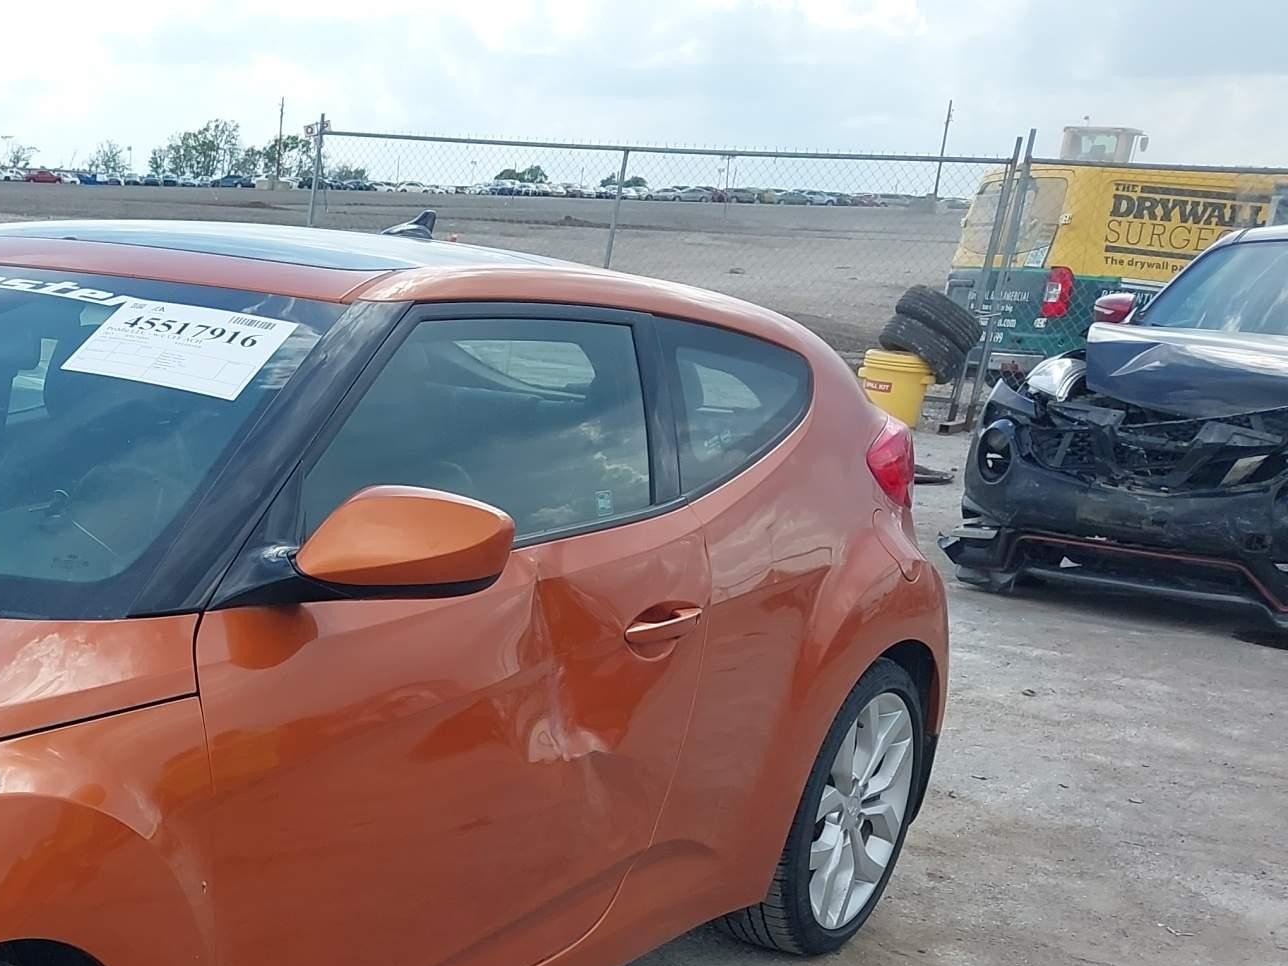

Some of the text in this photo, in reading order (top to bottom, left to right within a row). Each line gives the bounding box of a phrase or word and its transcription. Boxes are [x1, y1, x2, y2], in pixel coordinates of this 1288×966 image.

[1114, 182, 1139, 193] THE
[1109, 193, 1267, 227] DRYWALL
[1104, 256, 1125, 266] The
[1127, 257, 1169, 270] drywall
[123, 315, 264, 348] 45517916
